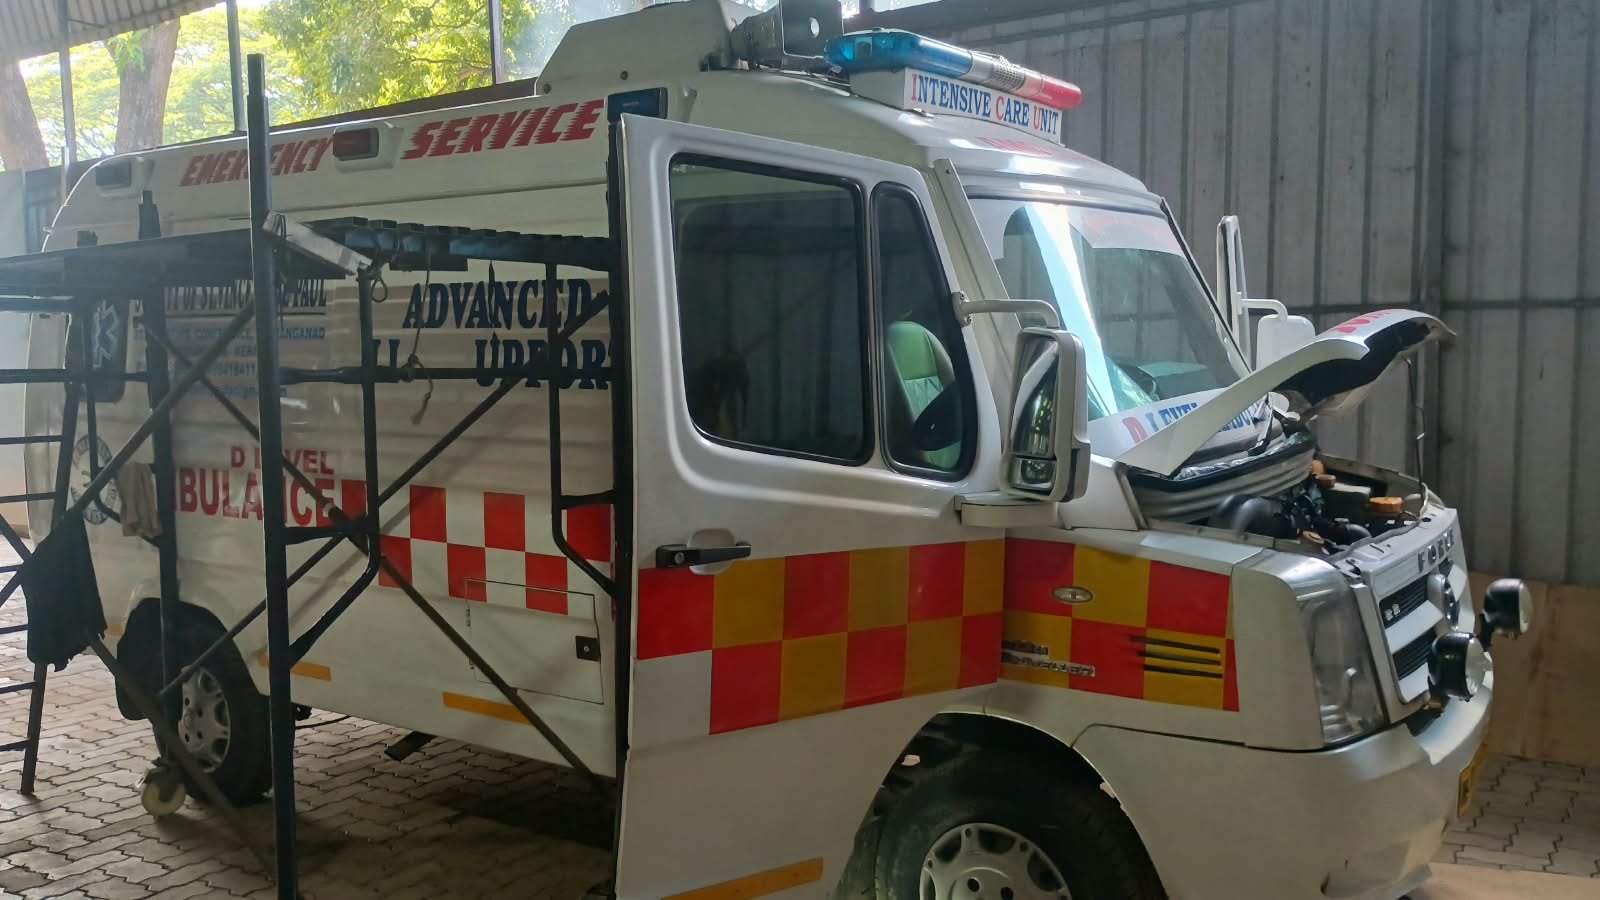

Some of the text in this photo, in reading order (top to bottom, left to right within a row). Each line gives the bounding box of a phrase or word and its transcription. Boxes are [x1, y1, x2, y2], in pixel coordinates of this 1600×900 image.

[911, 73, 1058, 135] INTENSIVE CARE UNIT
[179, 98, 605, 187] EMERENCY SERVICE
[474, 338, 612, 390] UPPOR
[231, 446, 335, 475] D LVEL
[175, 467, 336, 528] BULACE
